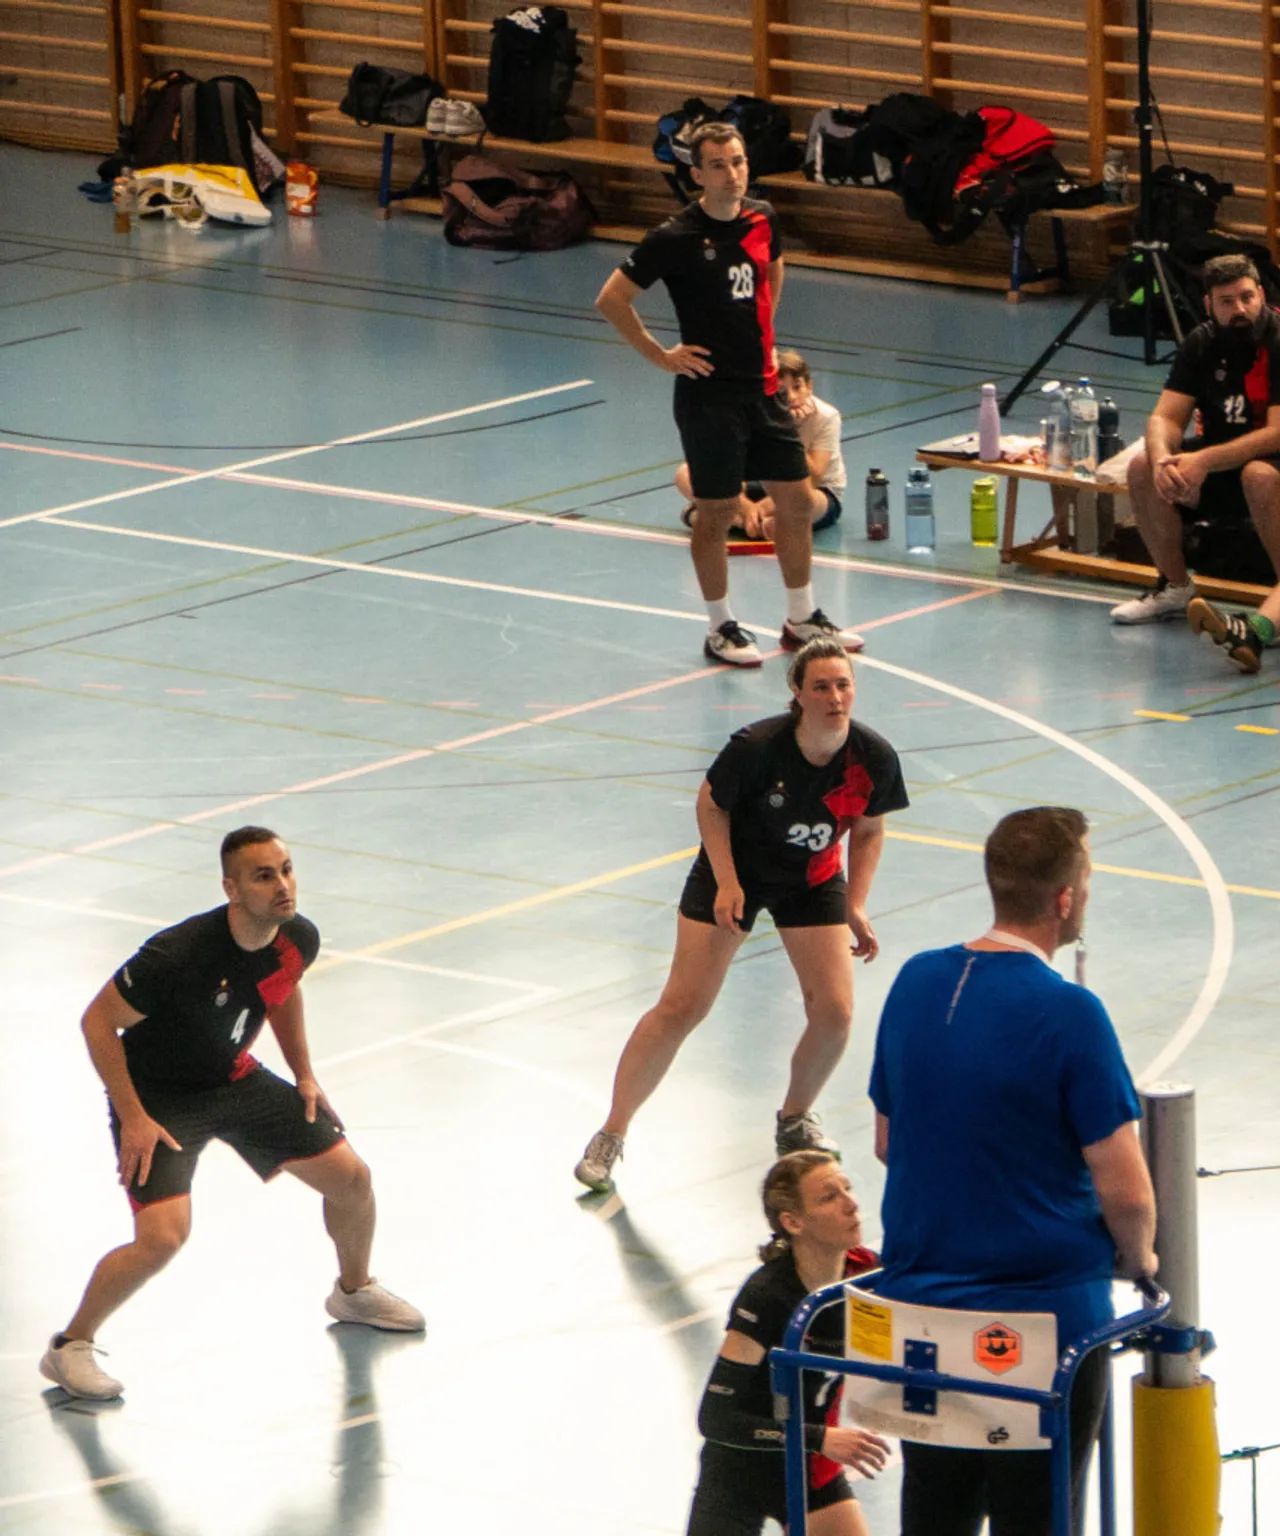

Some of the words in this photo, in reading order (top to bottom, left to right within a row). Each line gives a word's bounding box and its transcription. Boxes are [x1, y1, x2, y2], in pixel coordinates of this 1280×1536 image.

[728, 262, 754, 300] 28
[785, 823, 833, 852] 23
[230, 1007, 250, 1045] 4
